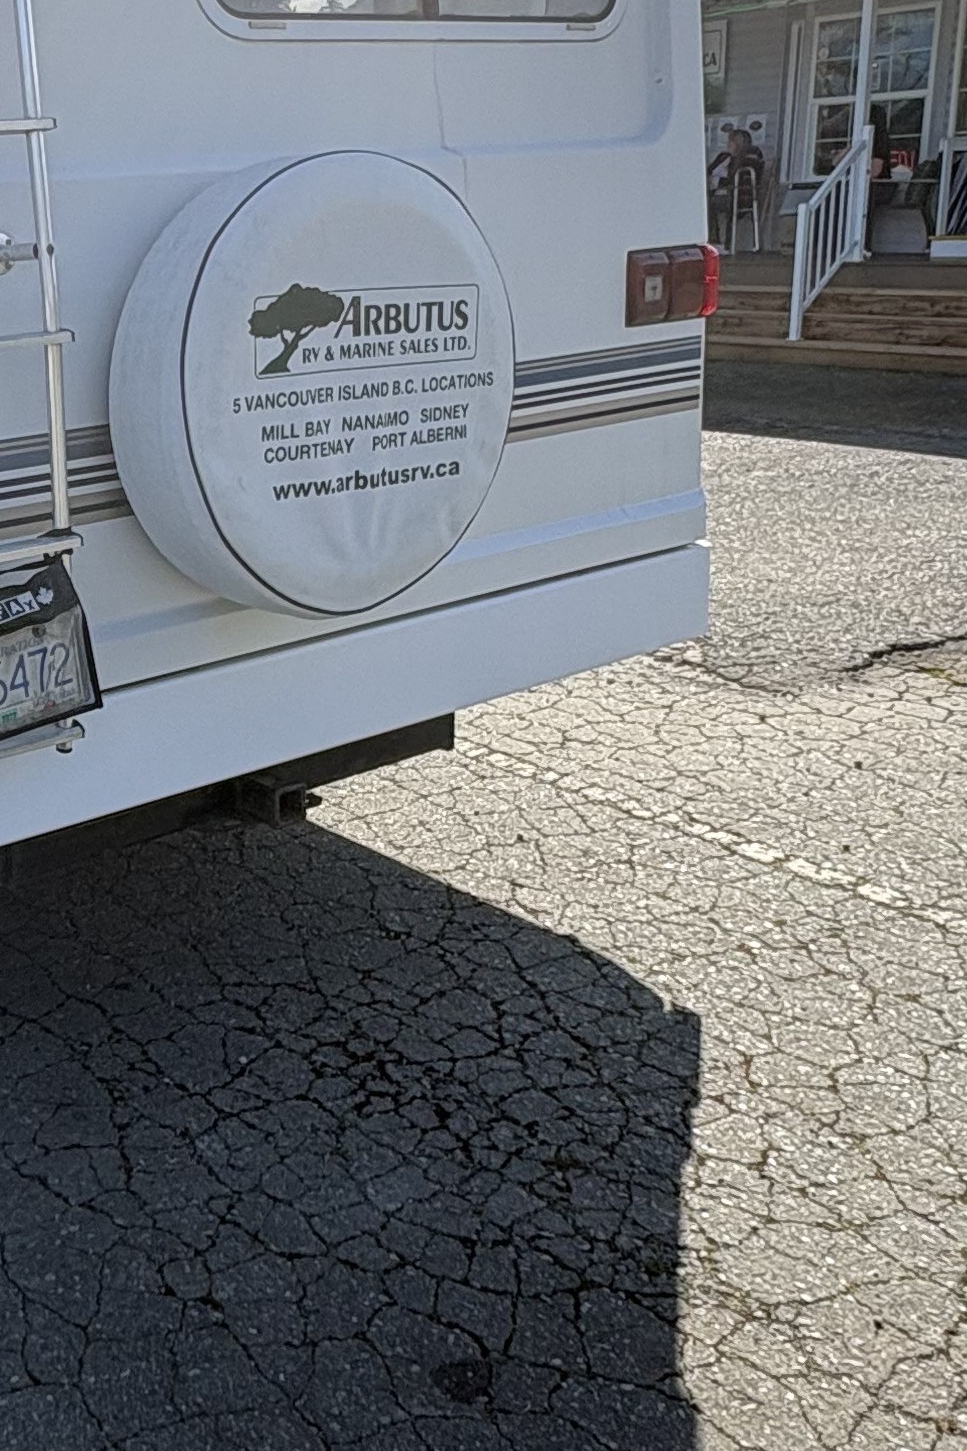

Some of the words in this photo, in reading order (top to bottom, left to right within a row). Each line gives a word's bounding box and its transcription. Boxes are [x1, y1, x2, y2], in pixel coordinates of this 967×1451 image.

[334, 296, 469, 338] ARBUTUS
[302, 347, 320, 364] RV
[324, 346, 335, 361] &
[339, 340, 395, 361] MARINE
[399, 337, 439, 355] SALES
[443, 335, 471, 352] LTD.
[233, 398, 241, 414] 5
[245, 387, 334, 411] VANCOUVER
[337, 381, 389, 401] ISLAND
[392, 379, 418, 396] B.C.
[421, 371, 494, 393] LOCATIONS
[261, 422, 300, 442] MILL
[305, 419, 331, 438] BAY
[341, 410, 410, 432] NANAIMO
[420, 403, 470, 424] SIDNEY
[264, 438, 355, 464] COURTENAY
[372, 432, 407, 451] PORT
[410, 424, 467, 446] ALBERNI
[273, 461, 460, 501] www.arbutusrv.ca
